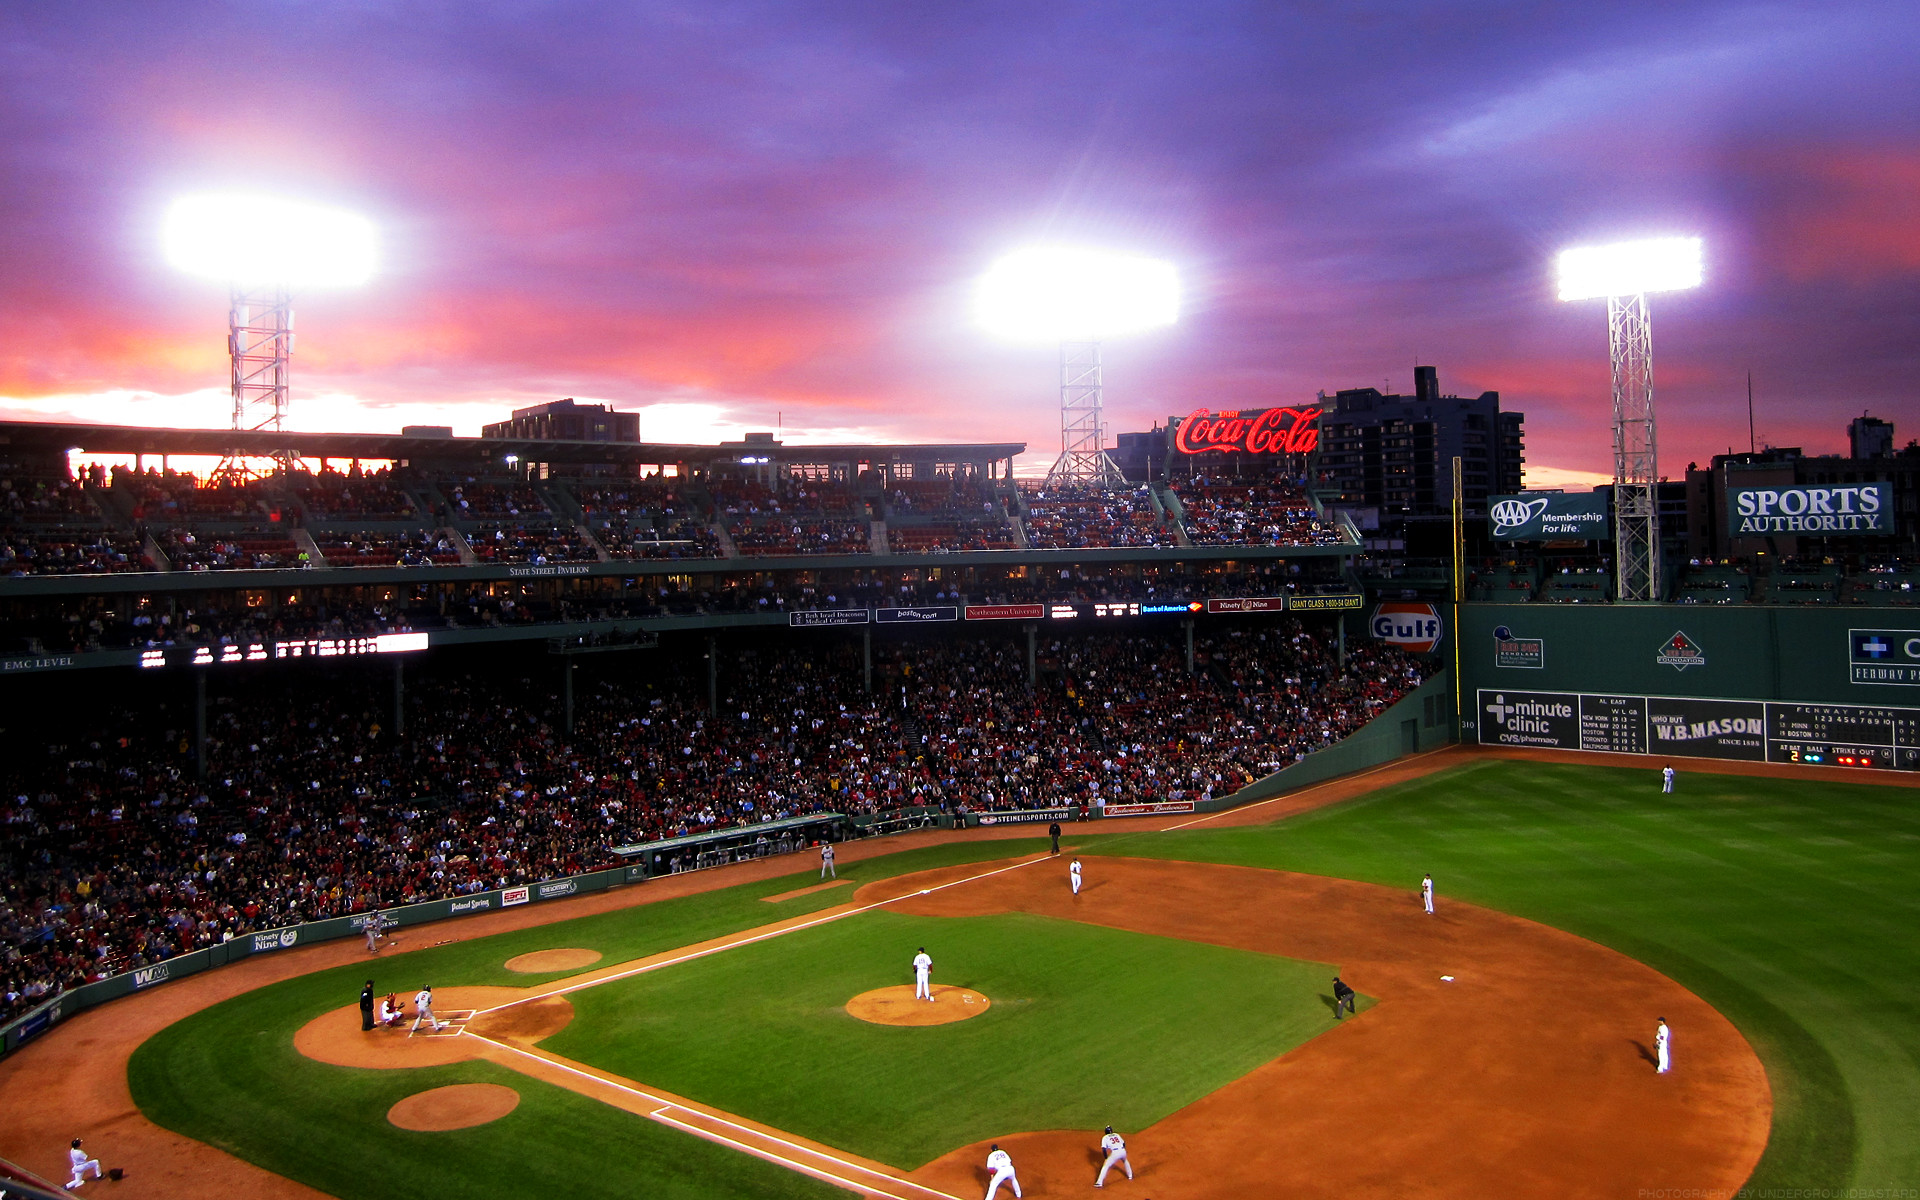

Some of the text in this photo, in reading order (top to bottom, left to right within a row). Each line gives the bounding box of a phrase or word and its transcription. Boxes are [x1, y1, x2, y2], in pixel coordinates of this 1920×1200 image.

[1175, 407, 1324, 454] Coca-Cola
[1737, 486, 1880, 517] SPORTS
[1494, 501, 1529, 526] AAA
[1542, 513, 1603, 523] Membership
[1738, 512, 1878, 533] AUTHORITY
[1542, 525, 1559, 533] For
[509, 566, 590, 576] STATE STREET PAVILION
[1143, 605, 1157, 613] Bank
[1164, 604, 1188, 612] America
[1292, 600, 1307, 608] GIANT
[1308, 599, 1325, 608] GLASS
[1344, 598, 1359, 607] GIANT
[969, 607, 1011, 616] Northeastern
[1012, 607, 1041, 615] University
[1374, 617, 1438, 638] Gulf
[4, 657, 75, 670] EMC LEVEL
[1856, 668, 1903, 680] FENWAY
[1515, 699, 1572, 718] minute
[1796, 706, 1894, 717] FENWAY PARK
[1461, 720, 1475, 729] 310
[1507, 716, 1550, 733] clinic
[1499, 733, 1559, 745] CVS/pharmacy
[1718, 738, 1741, 746] SINCE
[1583, 743, 1610, 751] BALTIMORE
[1806, 745, 1824, 753] BALL
[1831, 747, 1856, 755] STRIKE
[1859, 748, 1875, 756] OUT
[1790, 750, 1799, 762] 2
[504, 889, 527, 900] ESPN
[451, 899, 490, 912] Poland Spring
[254, 932, 279, 942] Ninety
[254, 940, 278, 951] Nine
[1109, 1136, 1120, 1144] 38
[994, 1152, 1006, 1161] 28
